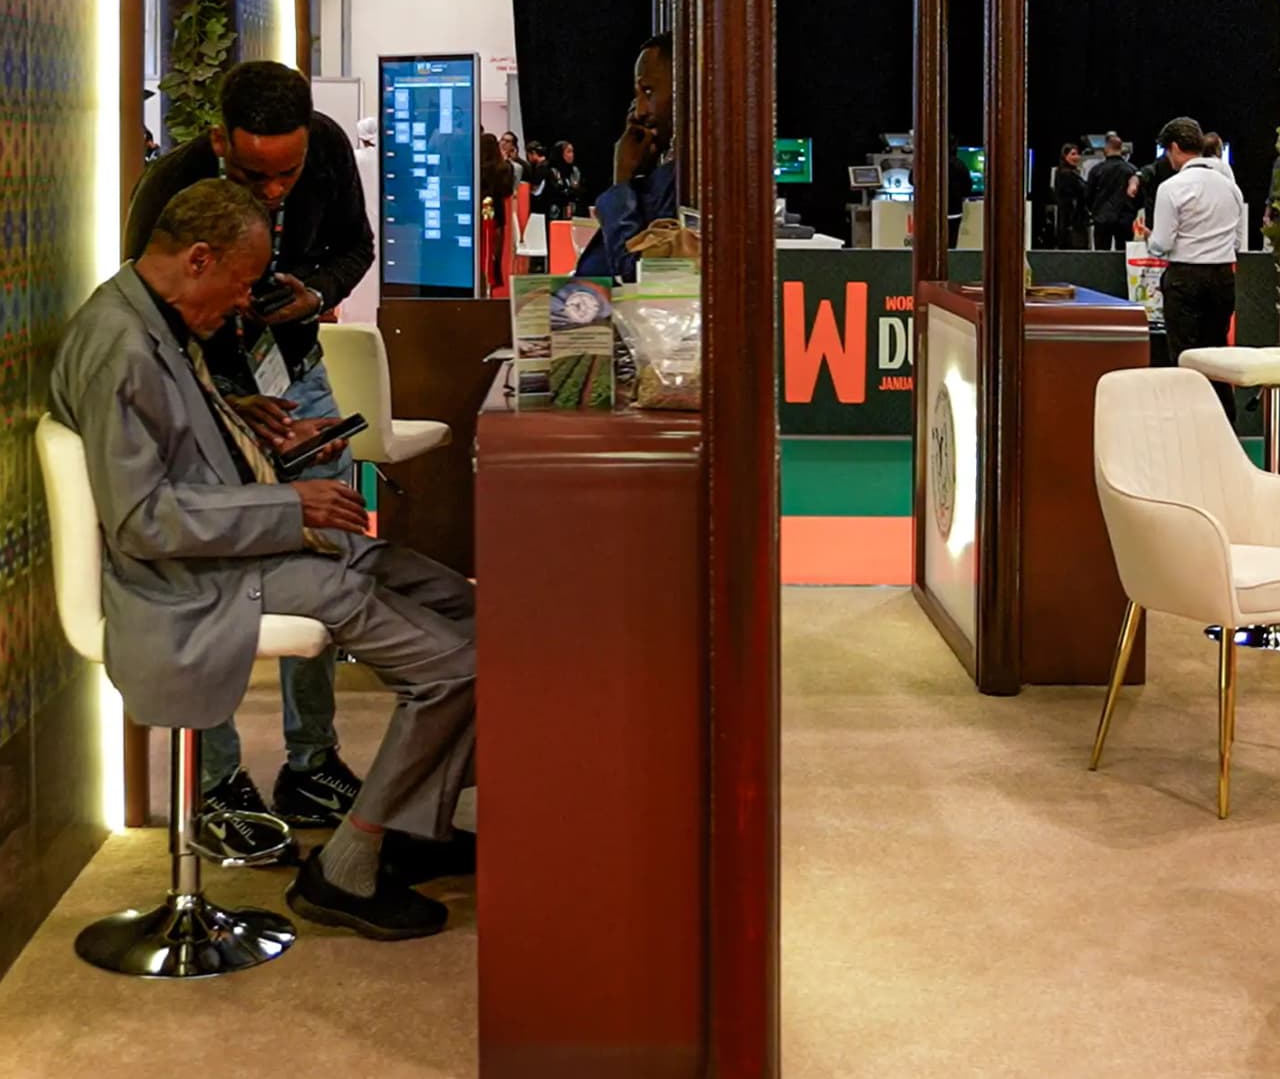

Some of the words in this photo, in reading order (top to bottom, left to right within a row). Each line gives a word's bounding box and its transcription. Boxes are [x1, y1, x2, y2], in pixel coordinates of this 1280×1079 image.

[885, 296, 914, 311] WOR
[783, 281, 868, 403] W
[878, 376, 913, 391] JANUA
